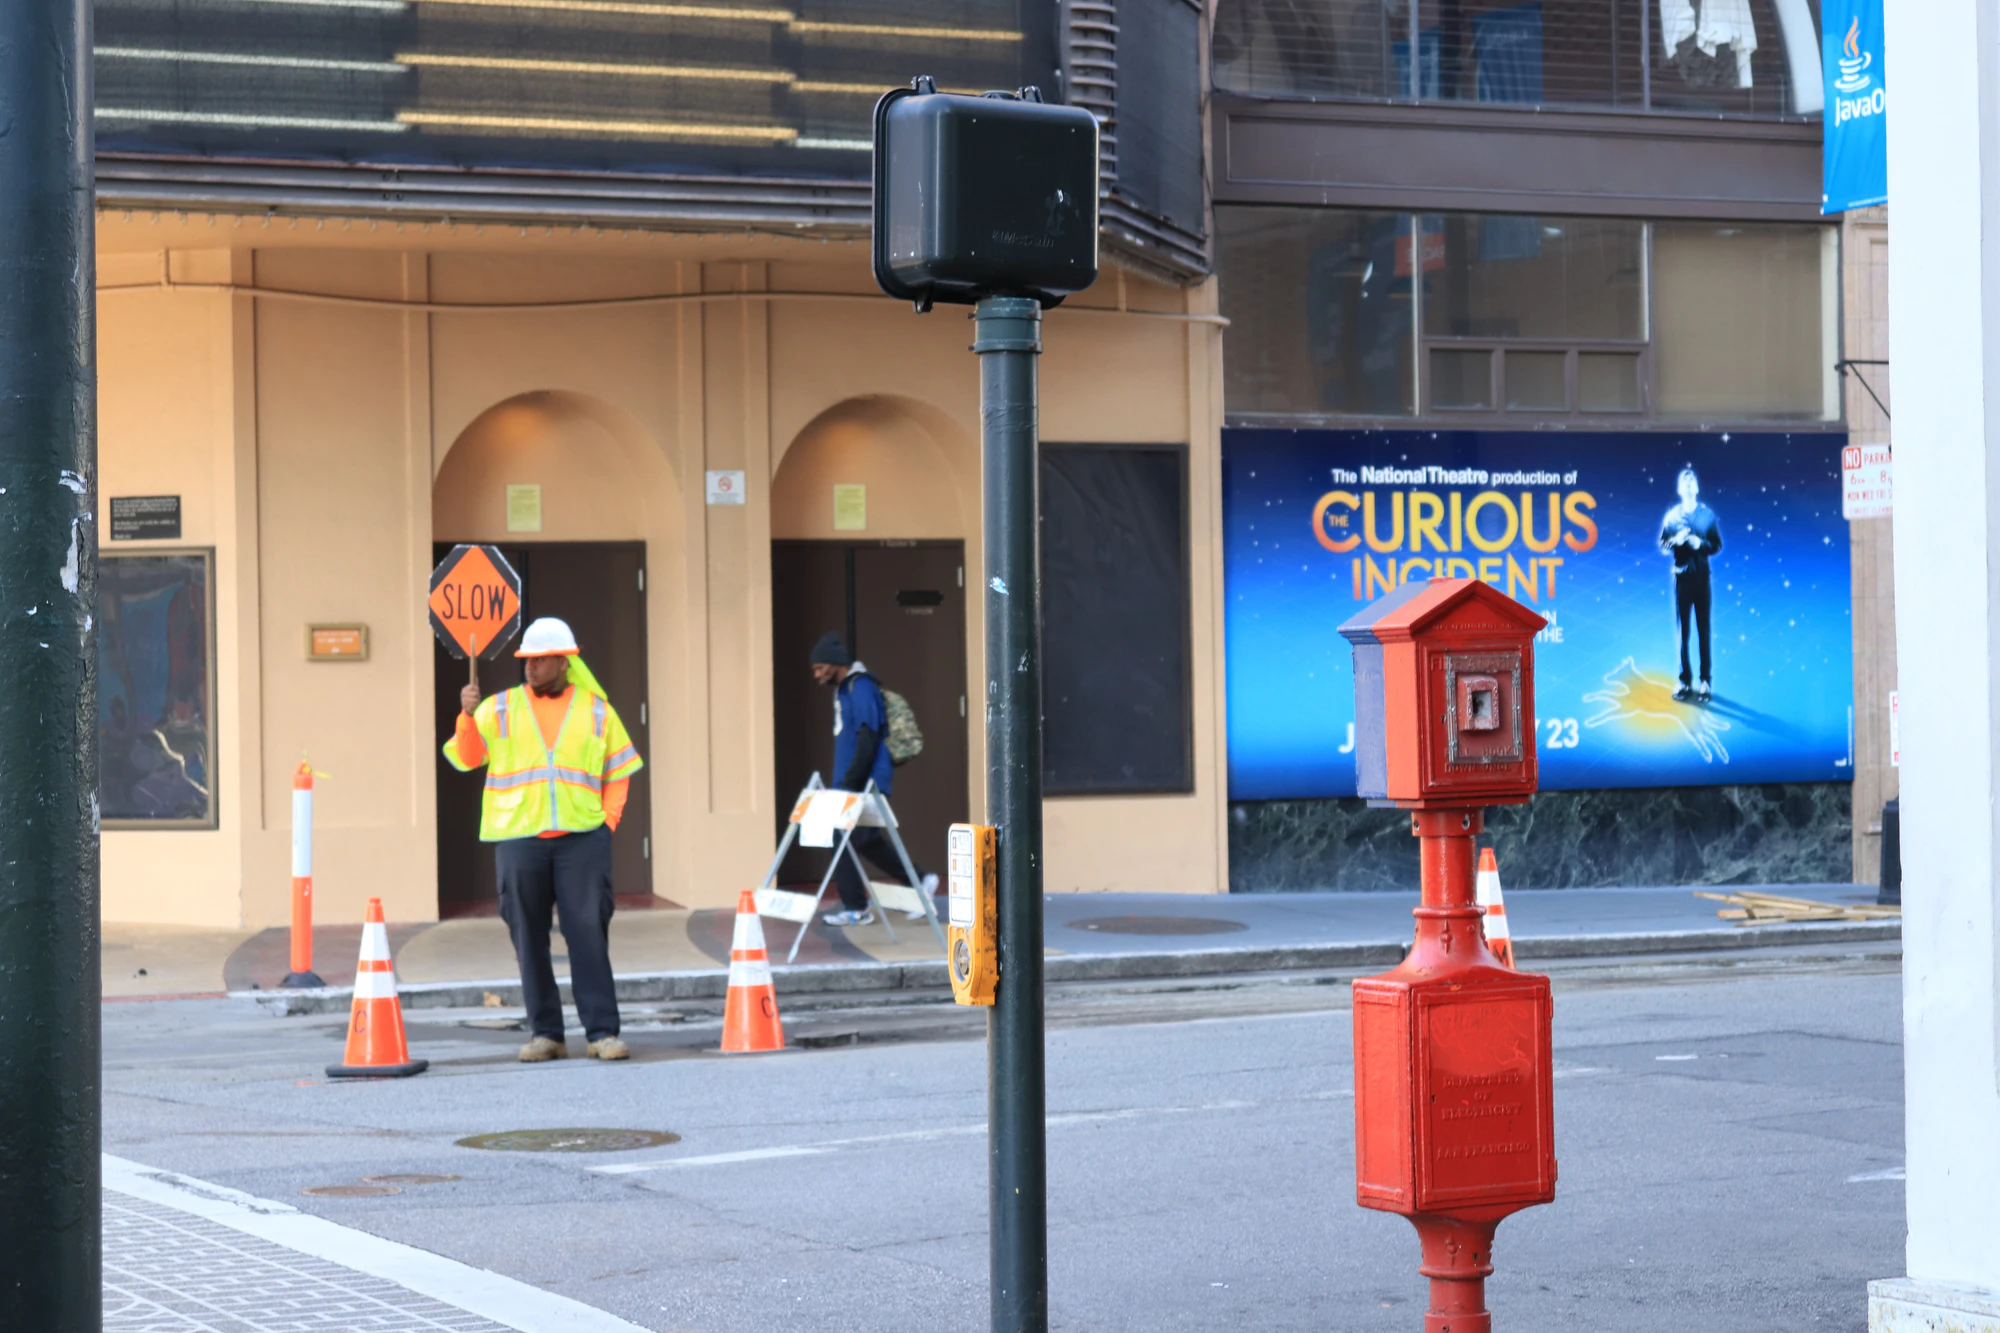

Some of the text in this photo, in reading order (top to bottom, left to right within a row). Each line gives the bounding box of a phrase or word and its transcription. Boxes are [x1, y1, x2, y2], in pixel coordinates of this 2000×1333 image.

[1834, 87, 1886, 127] JavaO
[1845, 449, 1892, 469] NO PARKIN
[1332, 465, 1578, 487] The National Theatre production of
[1312, 490, 1599, 553] CURIOUS
[1329, 514, 1349, 527] THE
[442, 583, 506, 621] SLOW
[1546, 717, 1580, 749] 23
[761, 995, 775, 1019] C
[354, 1009, 367, 1034] C
